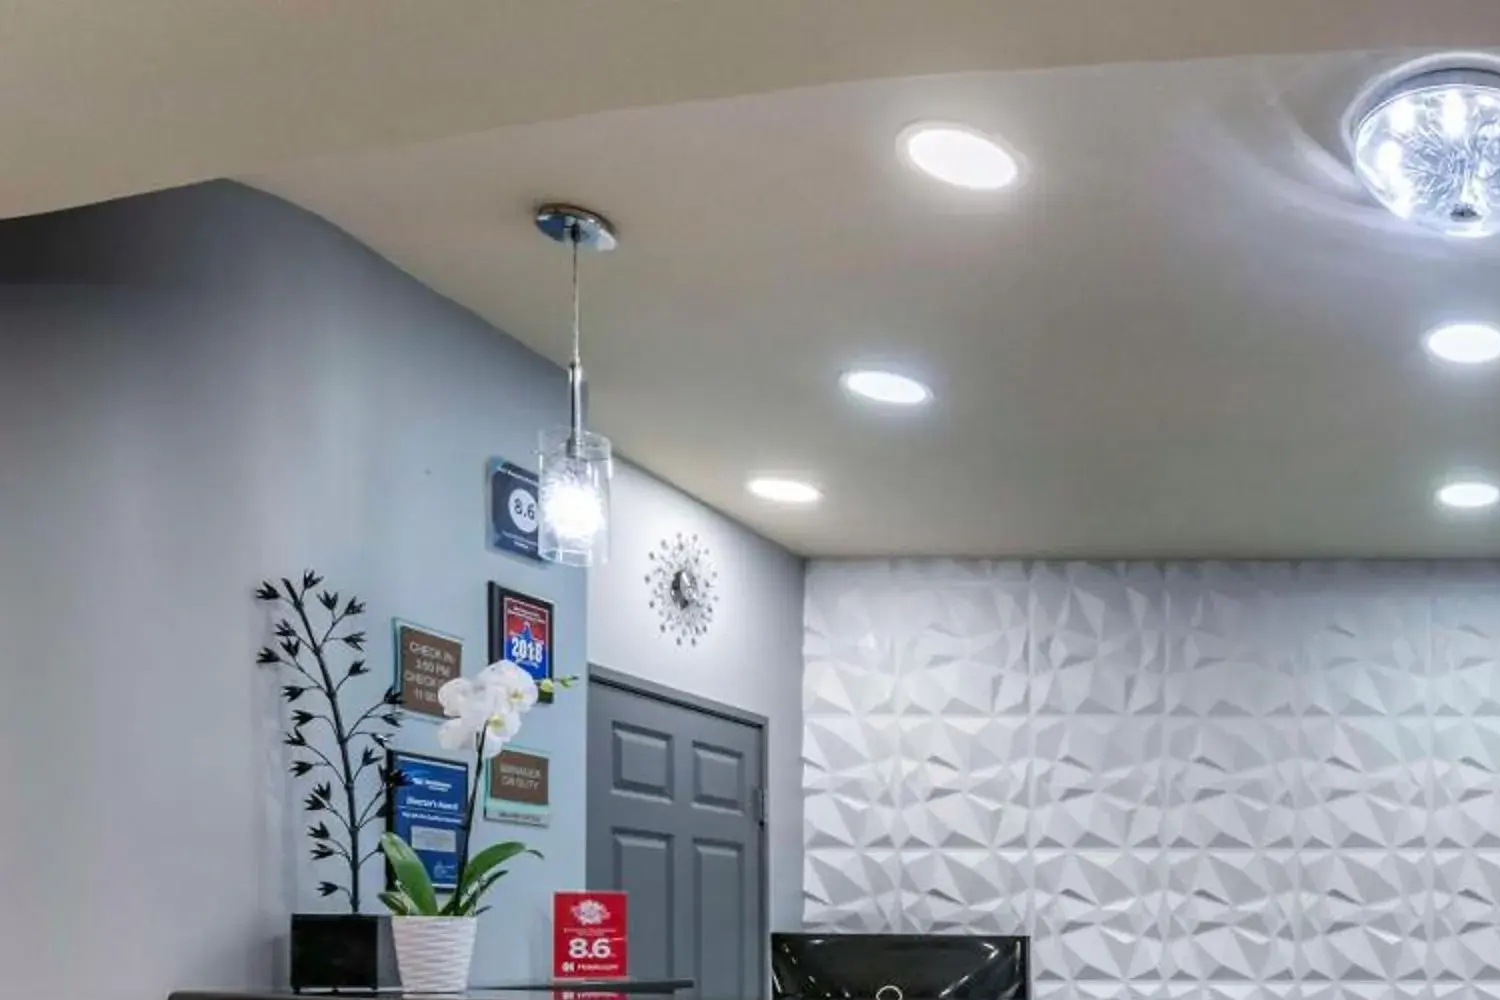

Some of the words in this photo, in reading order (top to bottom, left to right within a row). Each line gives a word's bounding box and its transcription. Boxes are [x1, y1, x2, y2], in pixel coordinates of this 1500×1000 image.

[513, 498, 536, 520] 8.6
[409, 641, 442, 661] CHECK
[511, 636, 543, 663] 2018
[568, 937, 612, 959] 8.6
